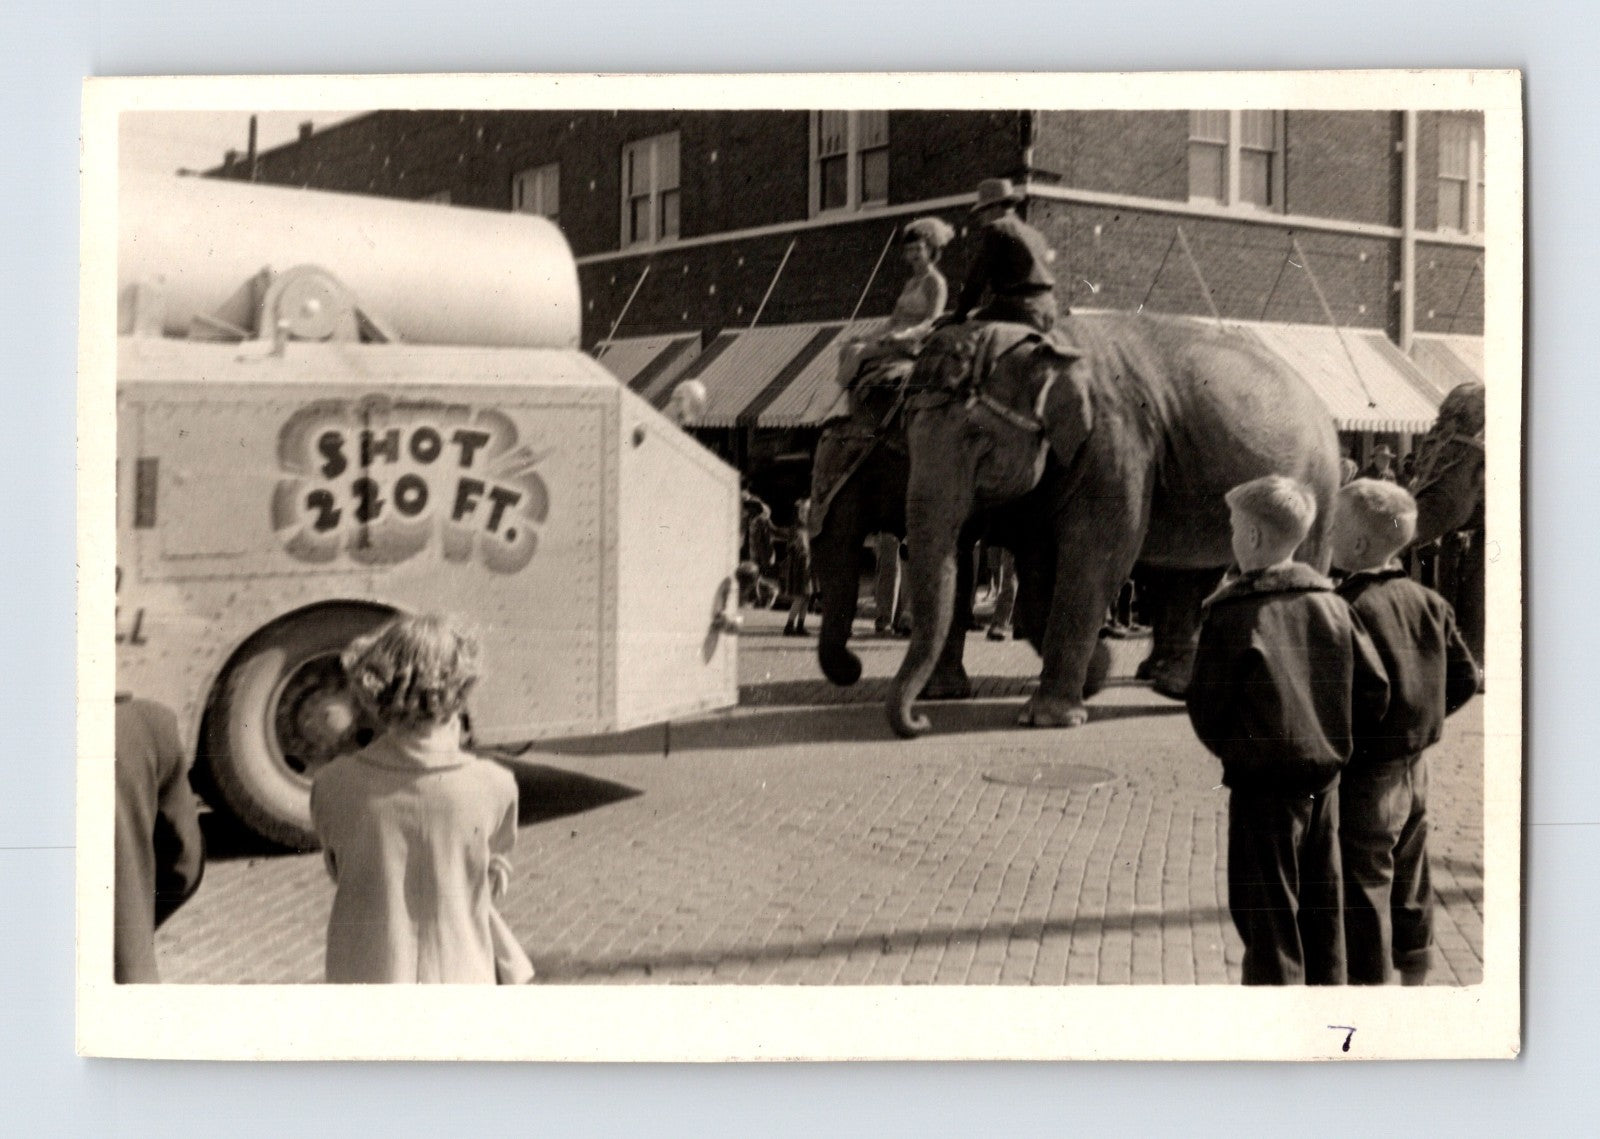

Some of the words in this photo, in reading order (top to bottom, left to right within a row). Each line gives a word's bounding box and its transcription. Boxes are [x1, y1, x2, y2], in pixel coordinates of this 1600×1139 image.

[317, 426, 491, 480] SHOT
[306, 473, 429, 533] 220
[452, 476, 523, 543] FT.
[1327, 1025, 1357, 1052] 7
